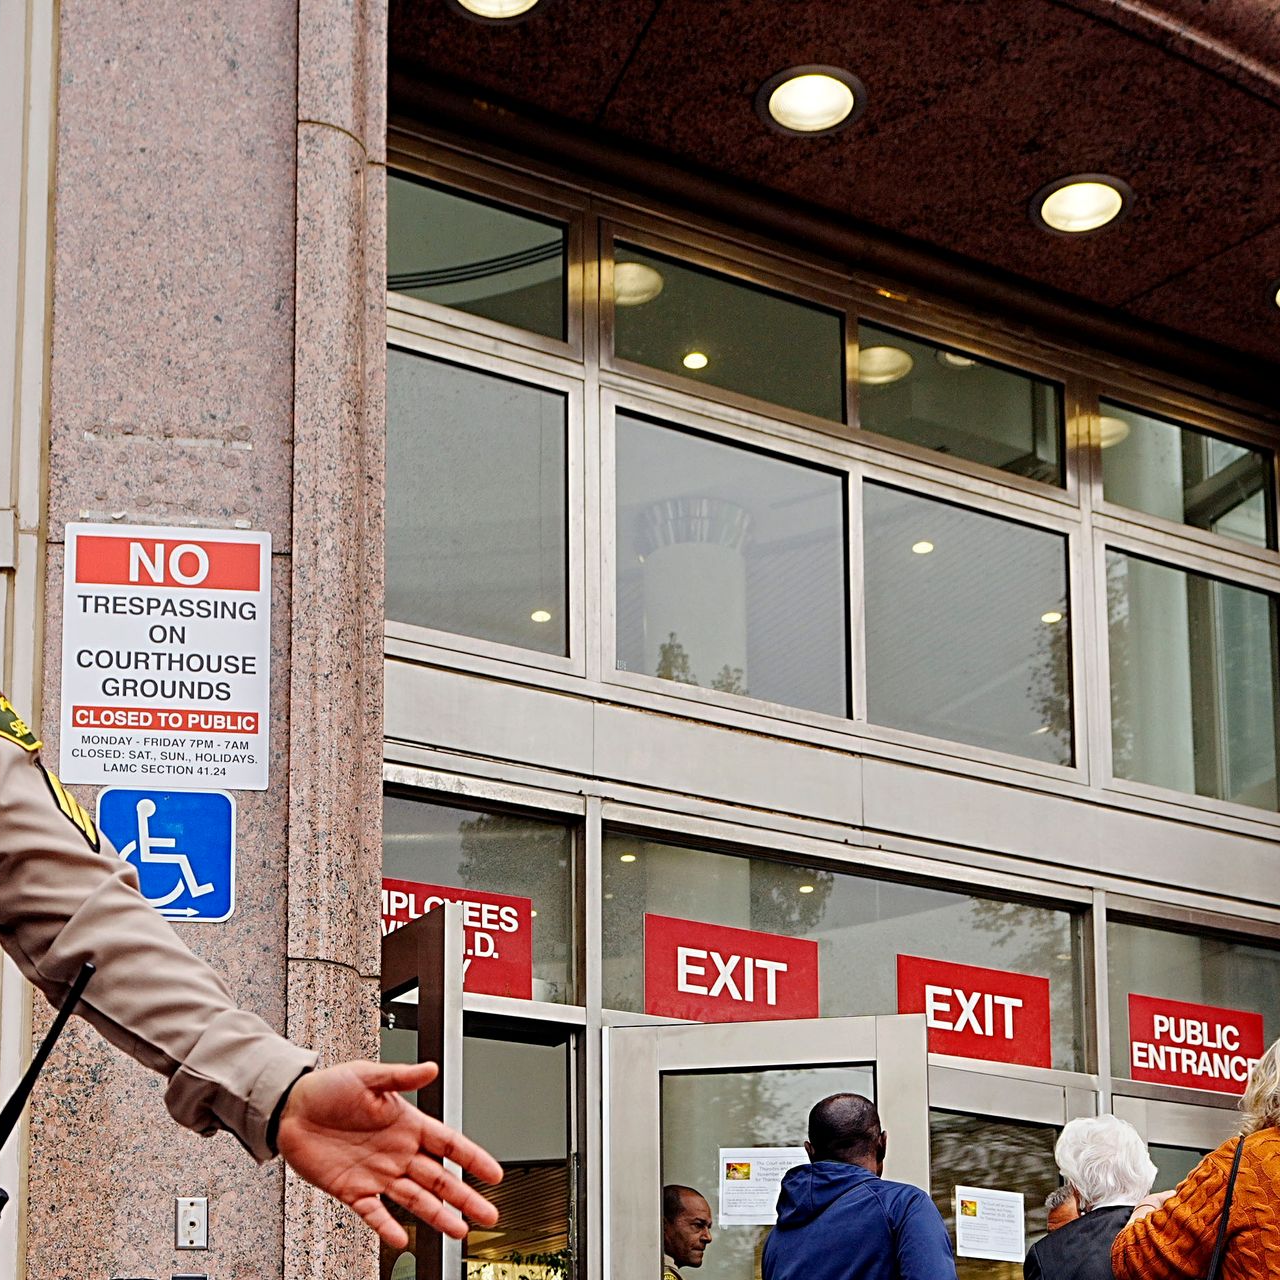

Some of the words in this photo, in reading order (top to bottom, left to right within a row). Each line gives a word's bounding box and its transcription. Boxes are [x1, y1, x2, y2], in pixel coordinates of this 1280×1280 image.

[128, 541, 210, 586] NO
[77, 595, 257, 621] TRESPASSING
[148, 625, 187, 645] ON
[76, 649, 257, 675] COURTHOUSE
[101, 677, 231, 701] GROUNDS
[75, 709, 154, 728] CLOSED
[157, 712, 187, 728] TO
[191, 713, 256, 731] PUBLIC
[80, 735, 133, 747] MONDAY
[143, 737, 187, 749] FRIDAY
[189, 739, 215, 749] 7PM
[224, 740, 250, 750] 7AM
[71, 748, 125, 761] CLOSED:
[128, 750, 157, 762] SAT.,
[159, 751, 192, 763] SUN.,
[195, 753, 258, 765] HOLIDAYS.
[103, 763, 137, 775] LAMC
[140, 764, 194, 776] SECTION
[196, 765, 227, 777] 41.24
[676, 945, 788, 1006] EXIT
[924, 984, 1023, 1040] EXIT
[1153, 1014, 1241, 1052] PUBLIC
